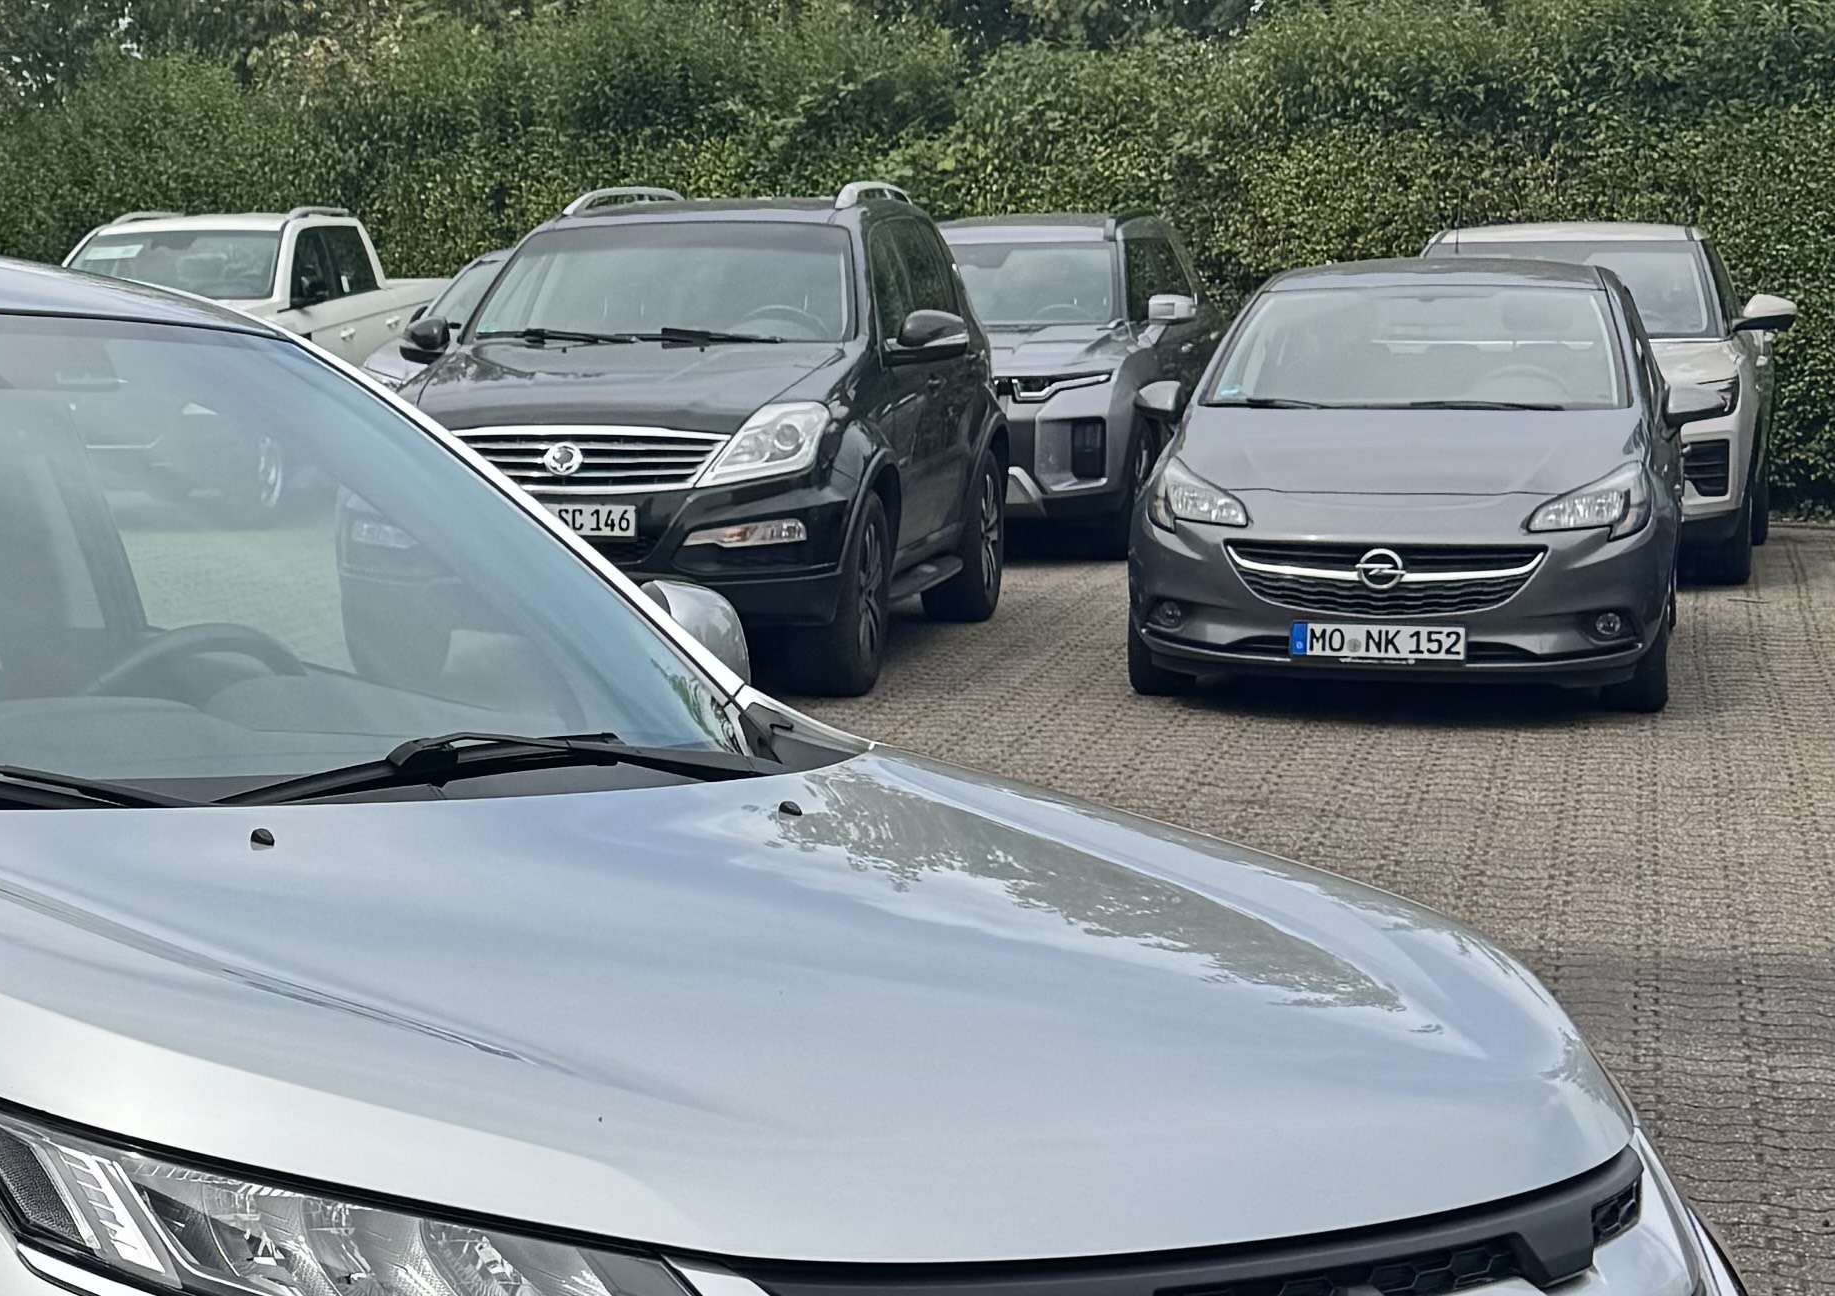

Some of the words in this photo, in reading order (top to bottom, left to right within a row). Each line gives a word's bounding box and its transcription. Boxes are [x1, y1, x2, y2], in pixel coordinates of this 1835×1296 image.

[590, 508, 630, 532] 146
[1309, 627, 1345, 652] MO
[1365, 628, 1400, 654] NK
[1408, 630, 1461, 656] 152
